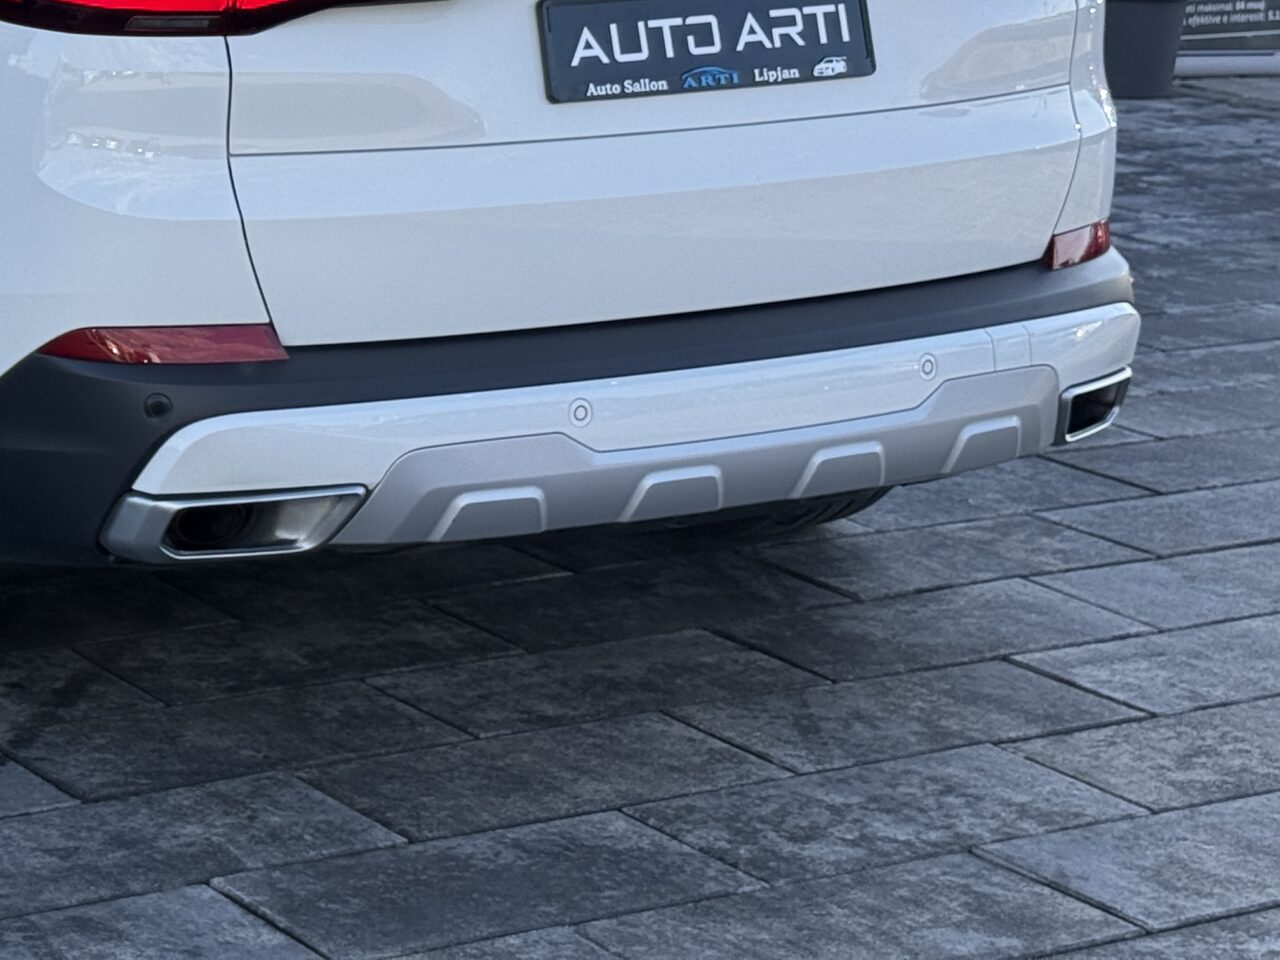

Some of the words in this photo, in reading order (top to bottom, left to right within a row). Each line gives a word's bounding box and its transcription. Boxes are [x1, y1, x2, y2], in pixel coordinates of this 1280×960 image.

[570, 14, 722, 67] AUTO
[736, 3, 851, 52] ARTI
[586, 81, 622, 97] Auto
[683, 71, 741, 89] ARTI
[754, 67, 800, 84] Lipjan
